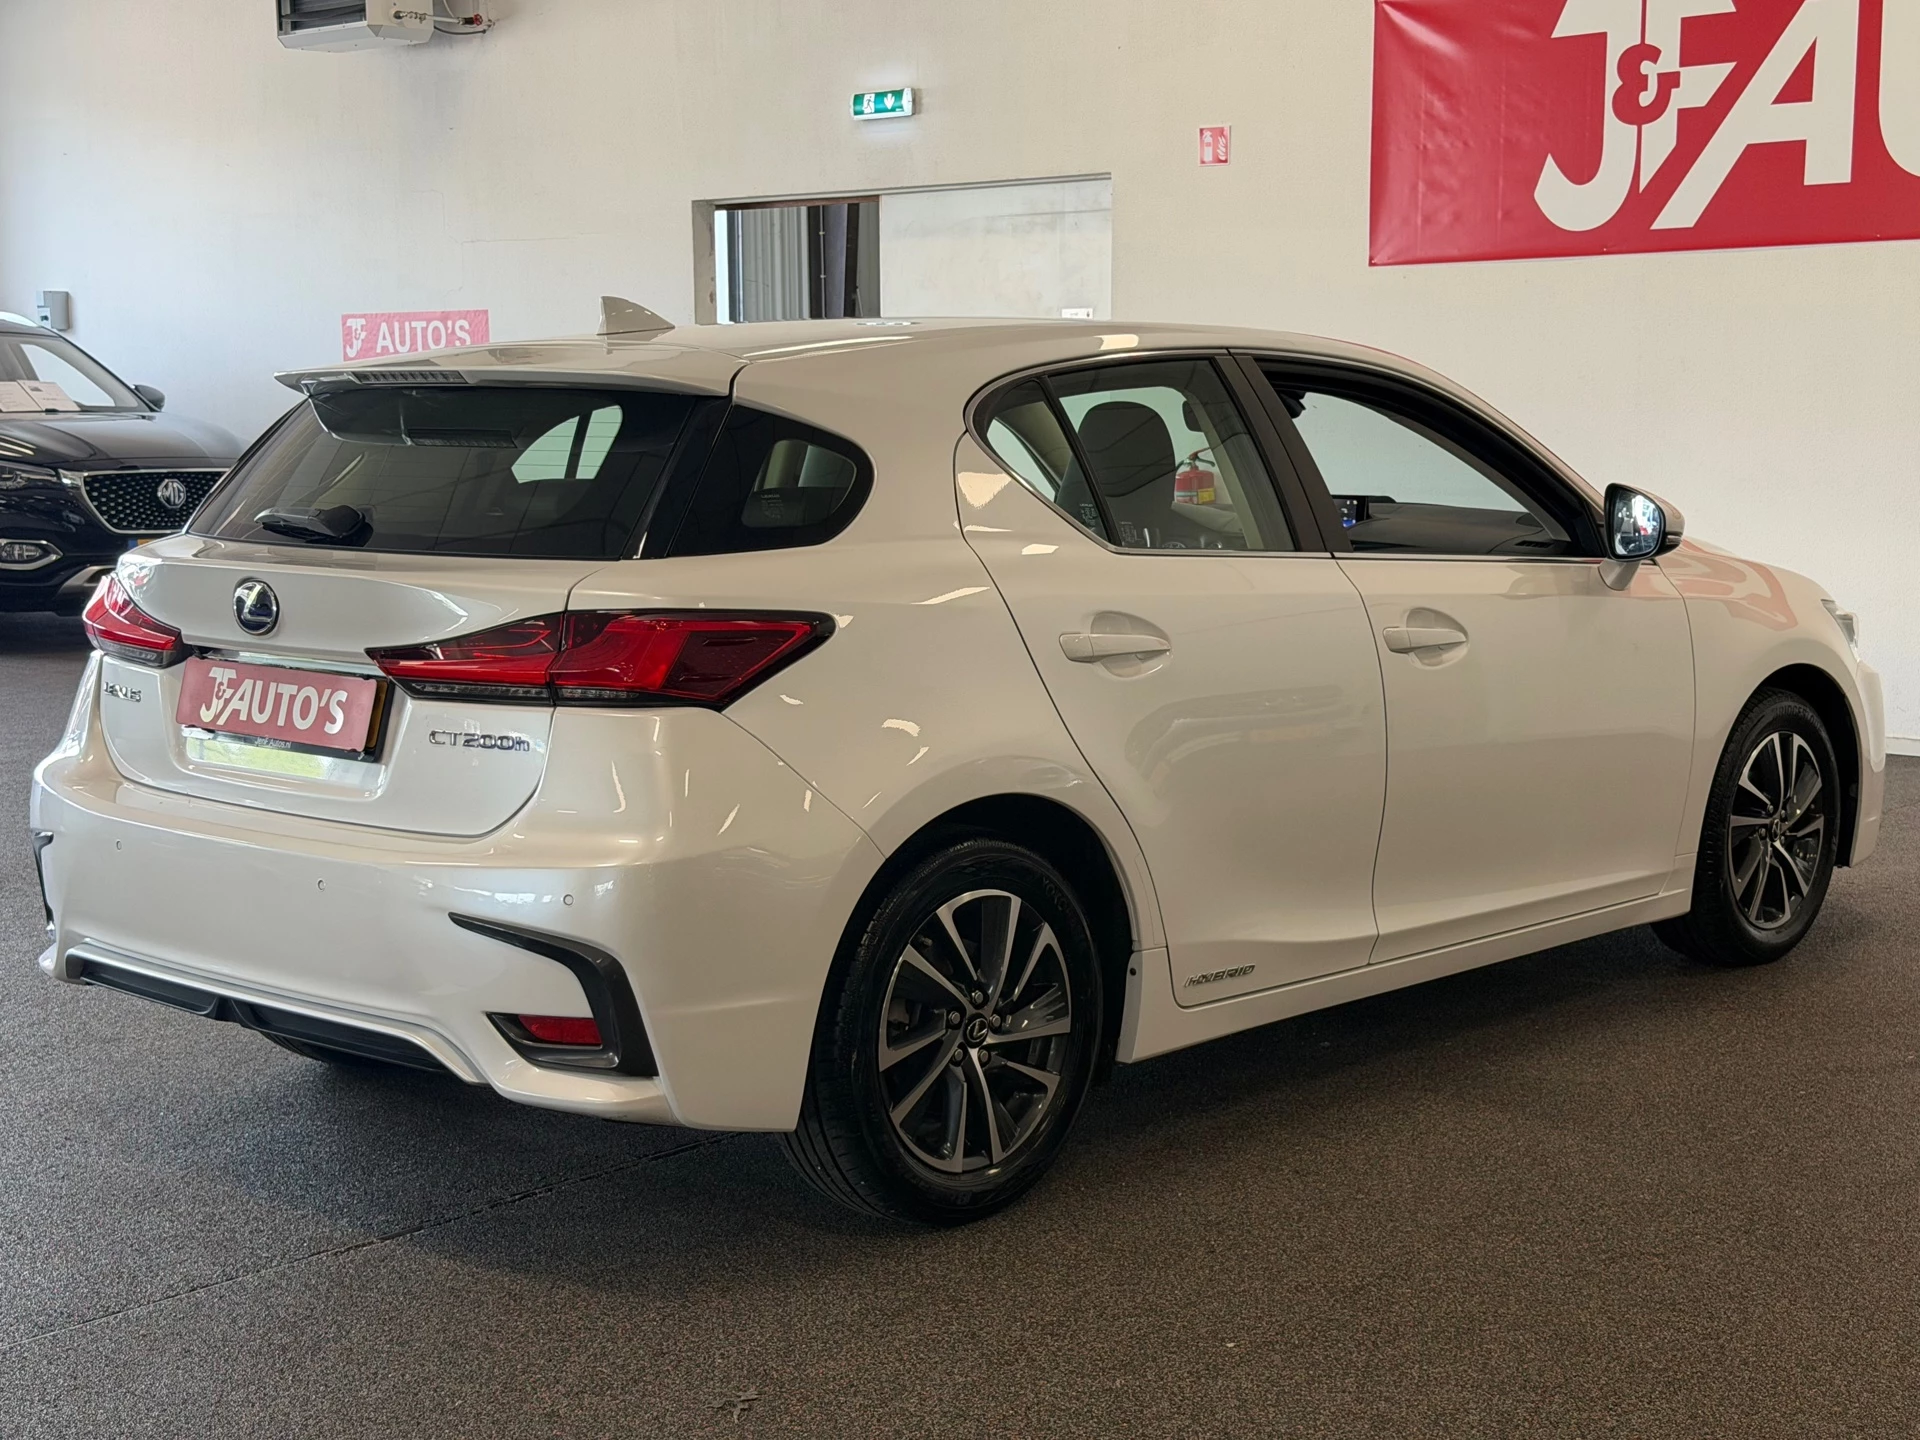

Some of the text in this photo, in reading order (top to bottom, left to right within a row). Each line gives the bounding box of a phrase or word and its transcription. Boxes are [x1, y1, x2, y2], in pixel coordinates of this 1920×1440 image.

[376, 319, 471, 353] AUTO'S
[217, 679, 348, 735] AUTO'S
[1183, 964, 1256, 988] HYBRID
